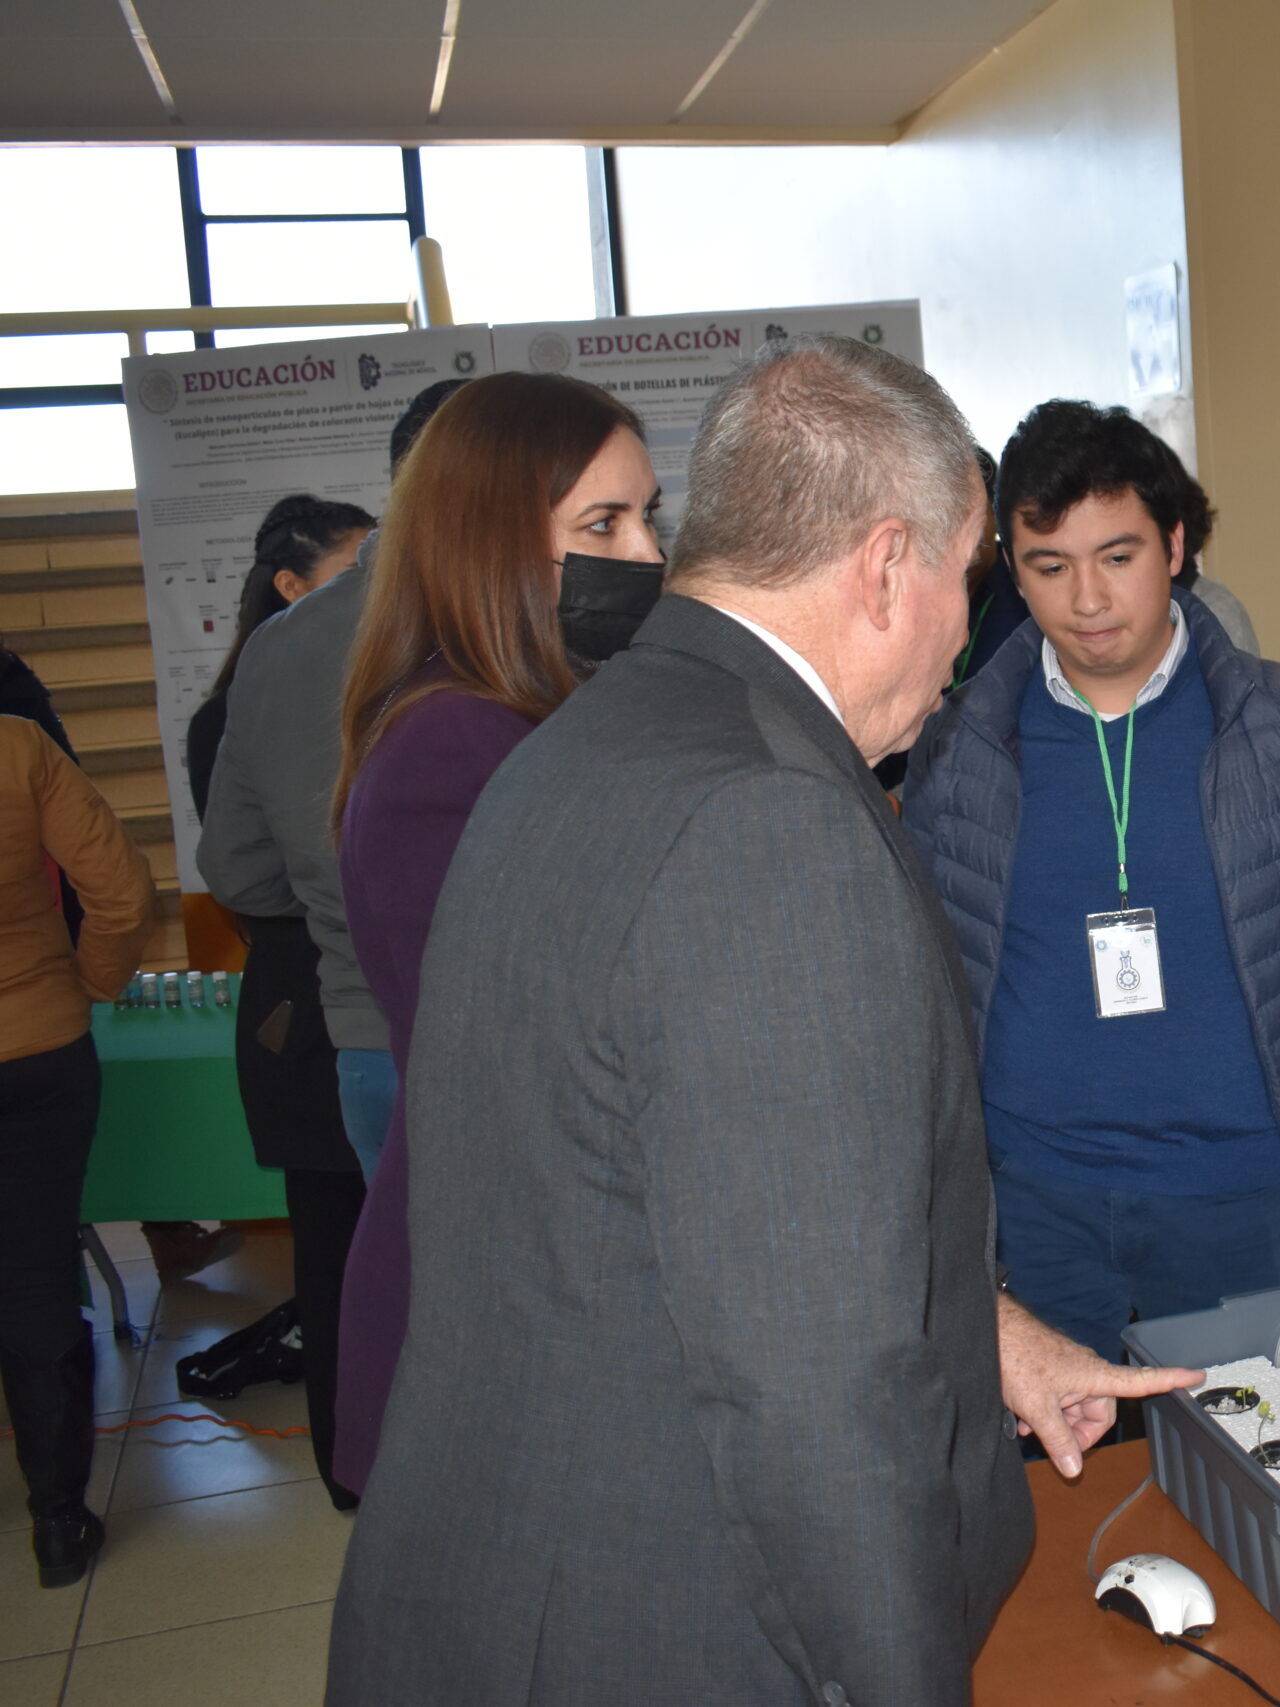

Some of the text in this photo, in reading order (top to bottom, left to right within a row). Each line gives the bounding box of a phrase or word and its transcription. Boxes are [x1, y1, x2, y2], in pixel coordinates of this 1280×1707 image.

[578, 324, 741, 355] EDUCACIÓN
[183, 355, 336, 393] EDUCACIÓN
[619, 381, 631, 392] DE
[633, 378, 678, 391] BOTELLAS
[678, 377, 690, 388] DE
